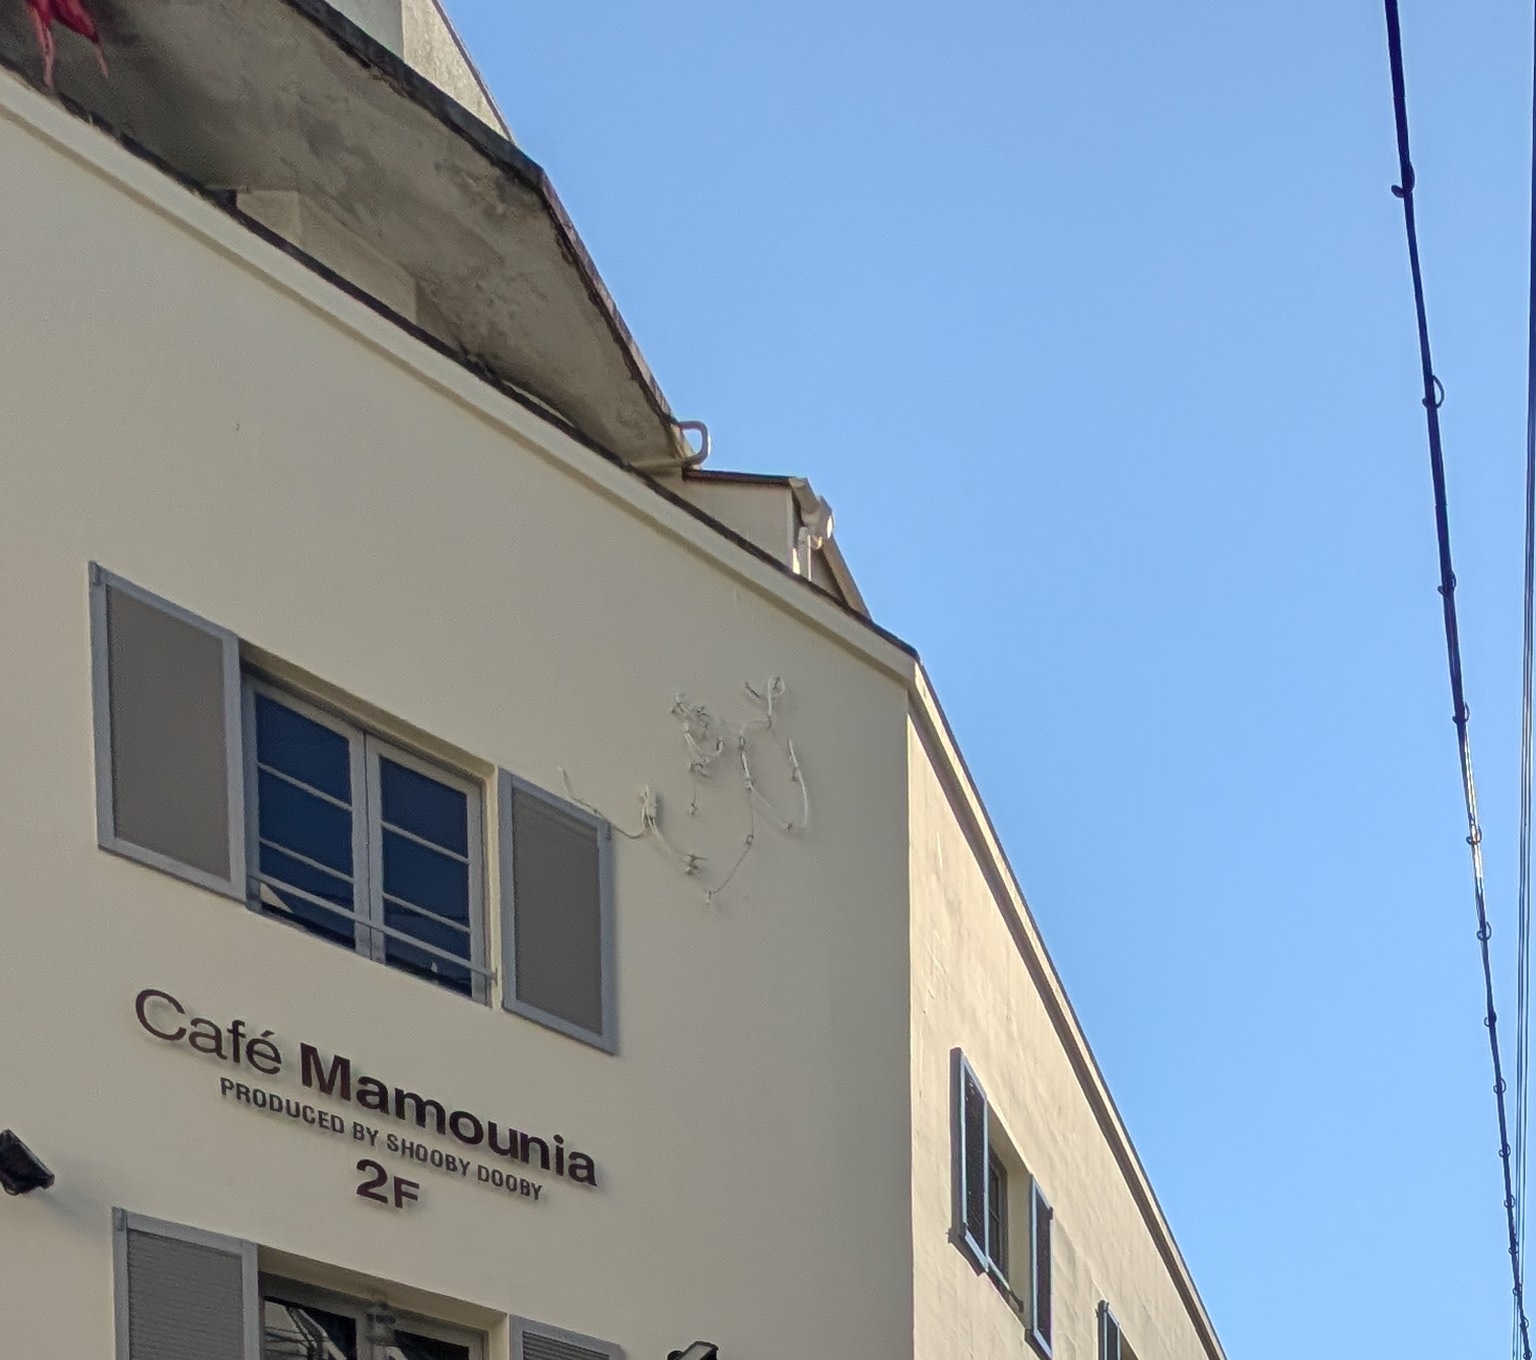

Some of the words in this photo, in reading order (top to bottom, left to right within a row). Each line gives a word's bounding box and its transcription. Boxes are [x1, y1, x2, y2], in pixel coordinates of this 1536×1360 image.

[135, 988, 283, 1075] Café
[299, 1042, 598, 1187] Mamounia
[220, 1076, 345, 1136] PRODUCED
[353, 1121, 380, 1147] BY
[386, 1133, 471, 1177] SHOOBY
[477, 1164, 543, 1201] DOOBY
[355, 1158, 420, 1209] 2F
